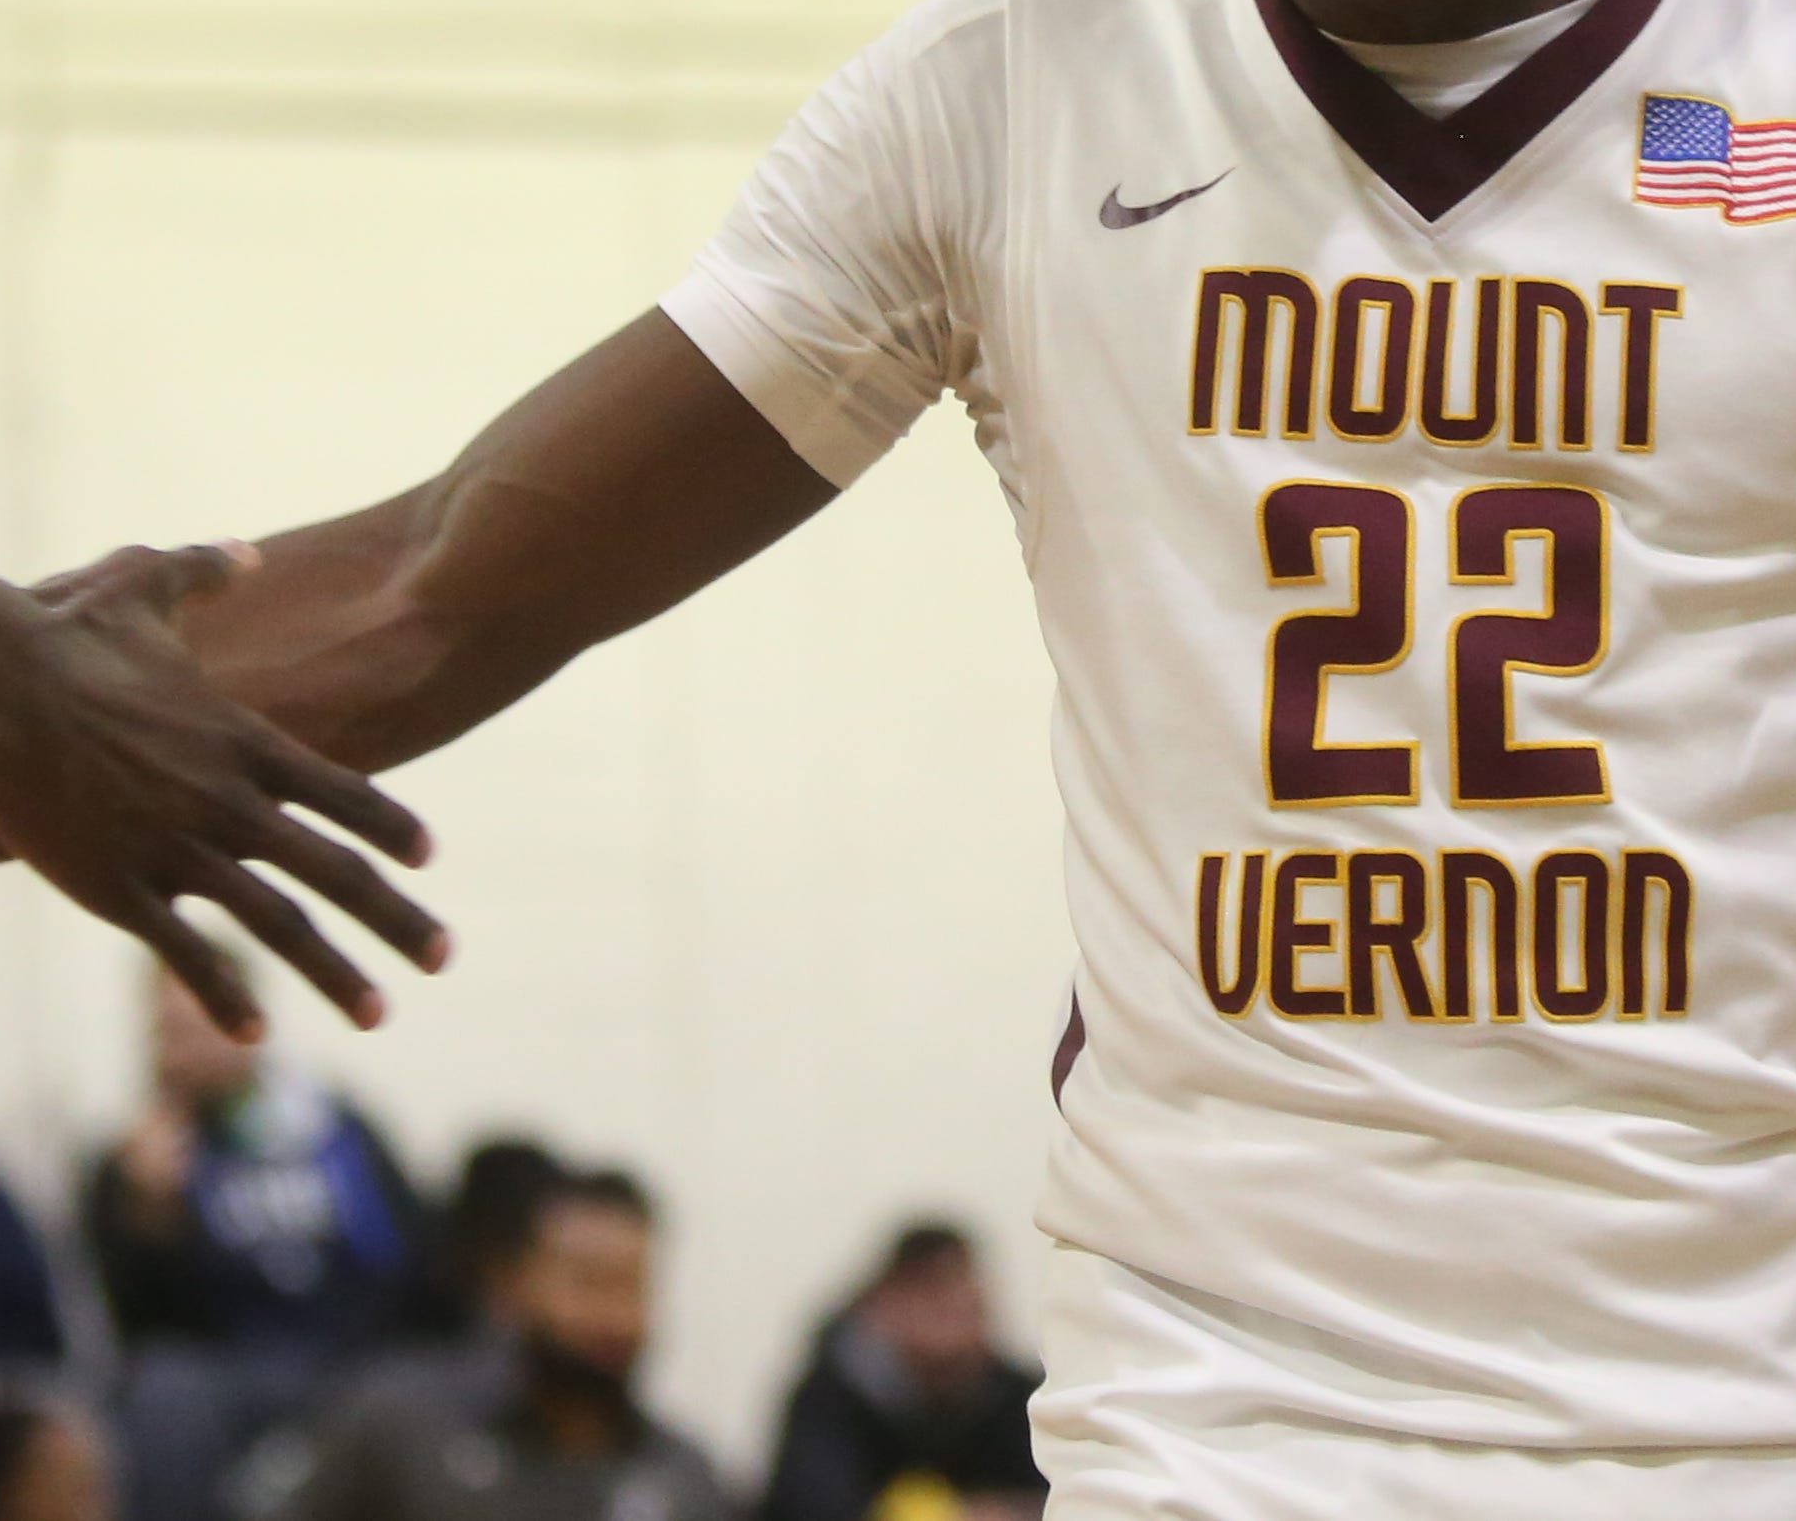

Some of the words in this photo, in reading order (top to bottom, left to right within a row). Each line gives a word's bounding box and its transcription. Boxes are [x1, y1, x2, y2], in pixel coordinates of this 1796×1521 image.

[1188, 266, 1684, 454] MOUNT
[1256, 479, 1612, 810] 22
[1196, 848, 1693, 1024] VERNON
